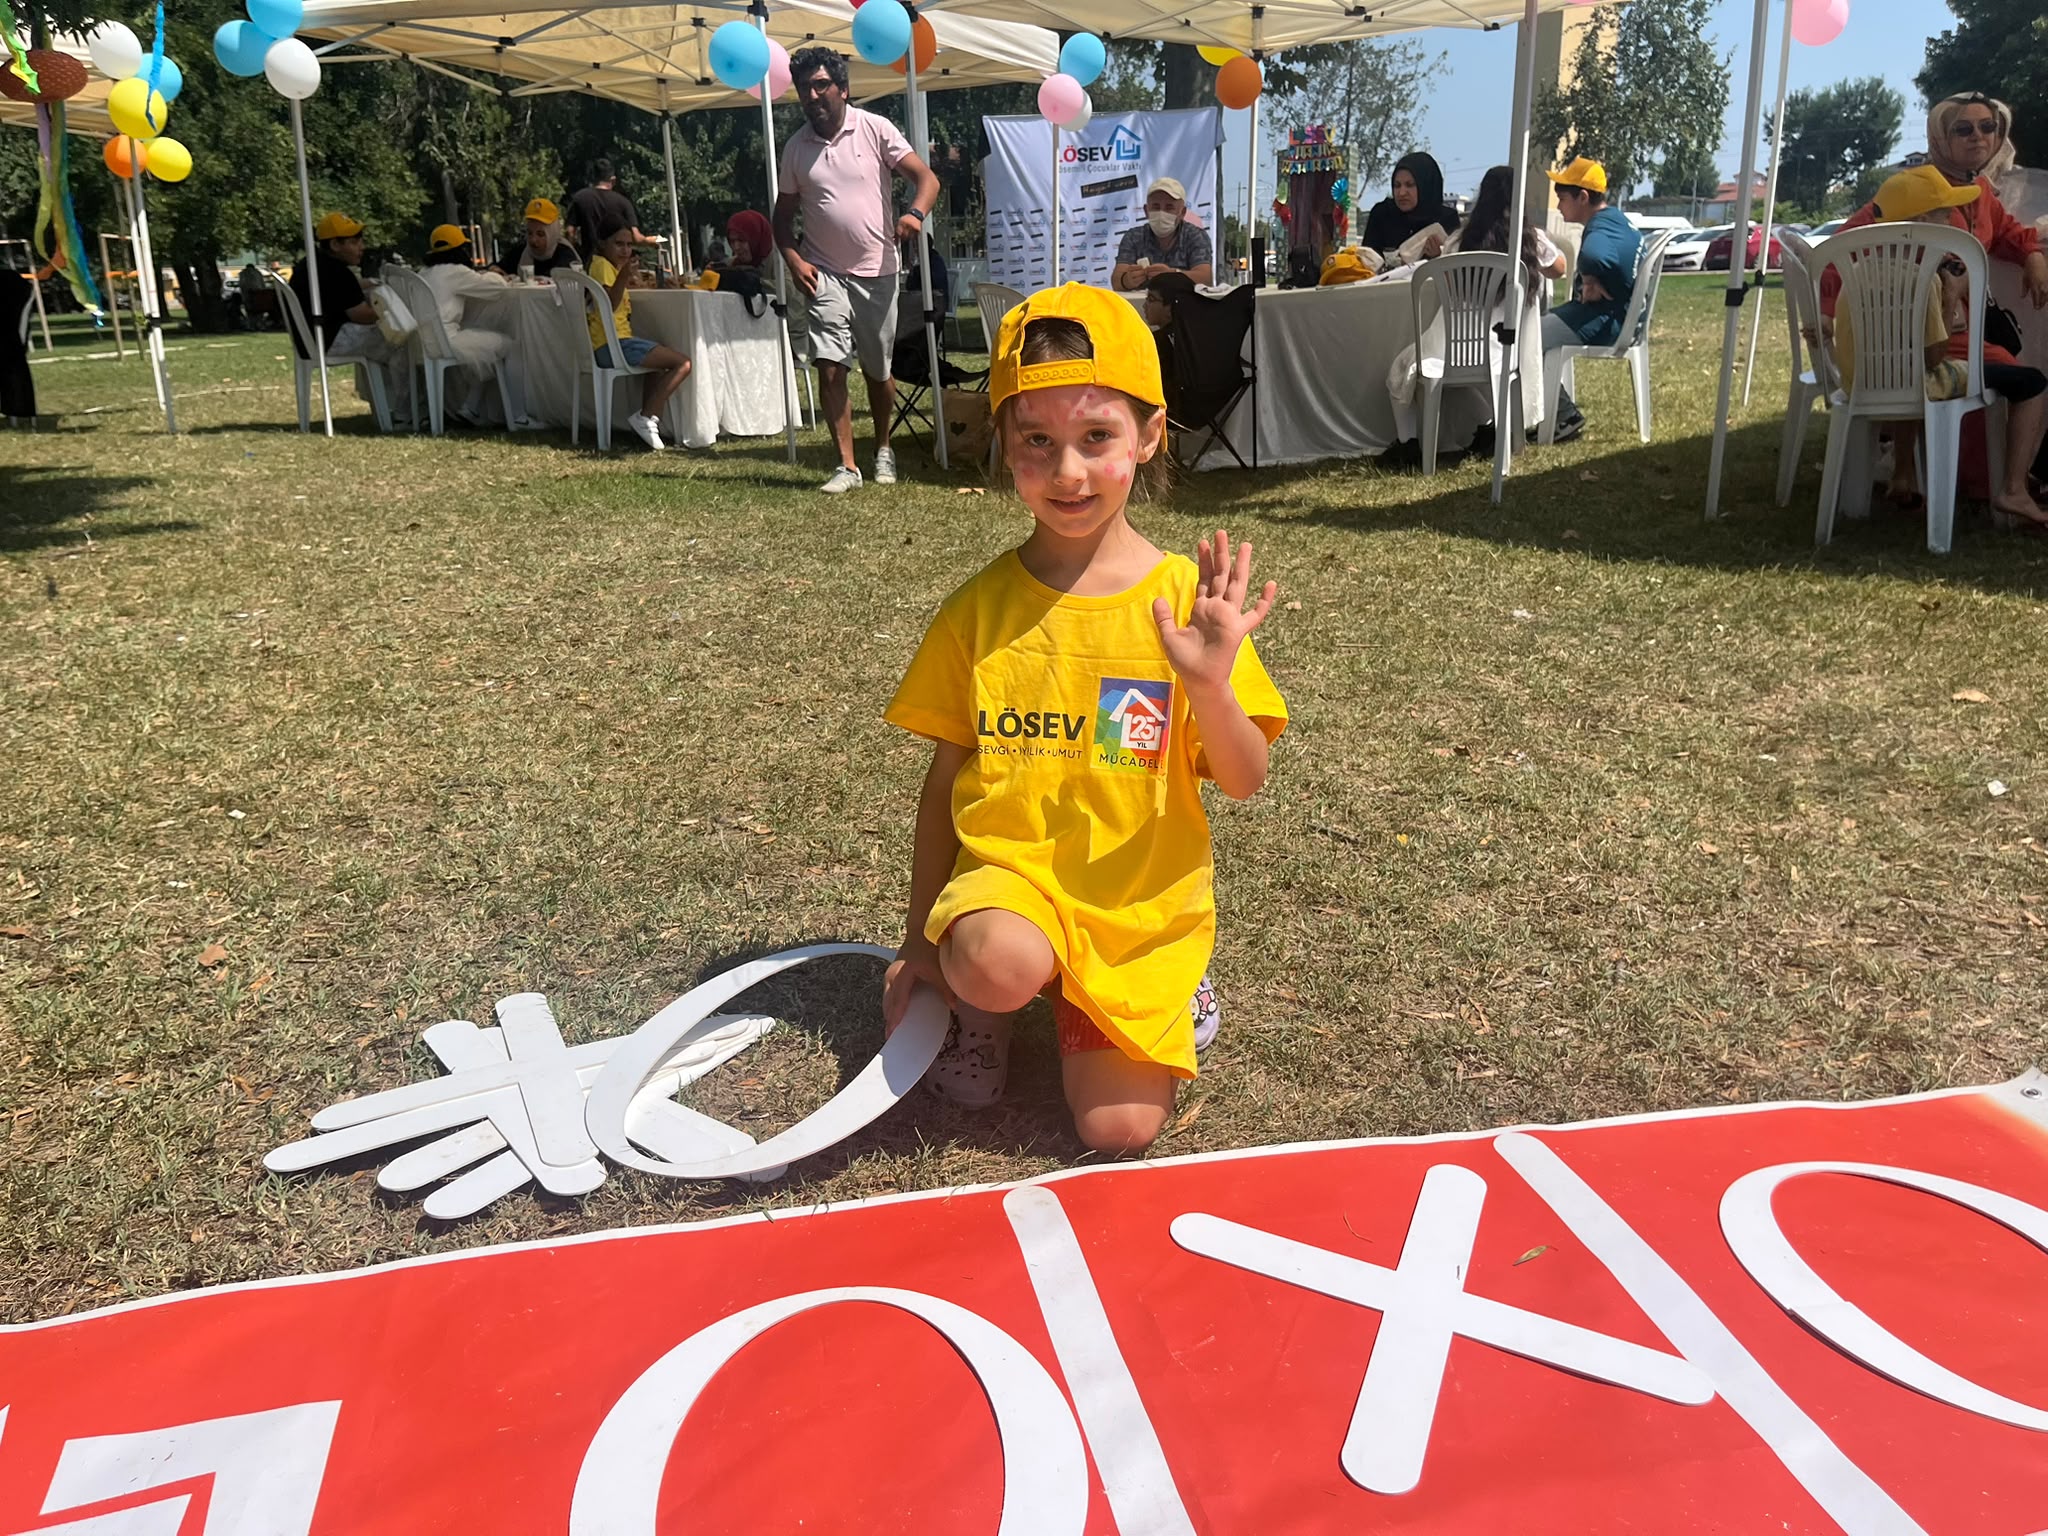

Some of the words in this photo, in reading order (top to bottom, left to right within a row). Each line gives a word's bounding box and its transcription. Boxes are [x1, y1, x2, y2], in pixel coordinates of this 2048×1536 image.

[978, 707, 1086, 741] LÖSEV
[1130, 714, 1155, 740] 25
[977, 744, 1009, 756] SEVGİ
[1052, 749, 1082, 760] UMUT
